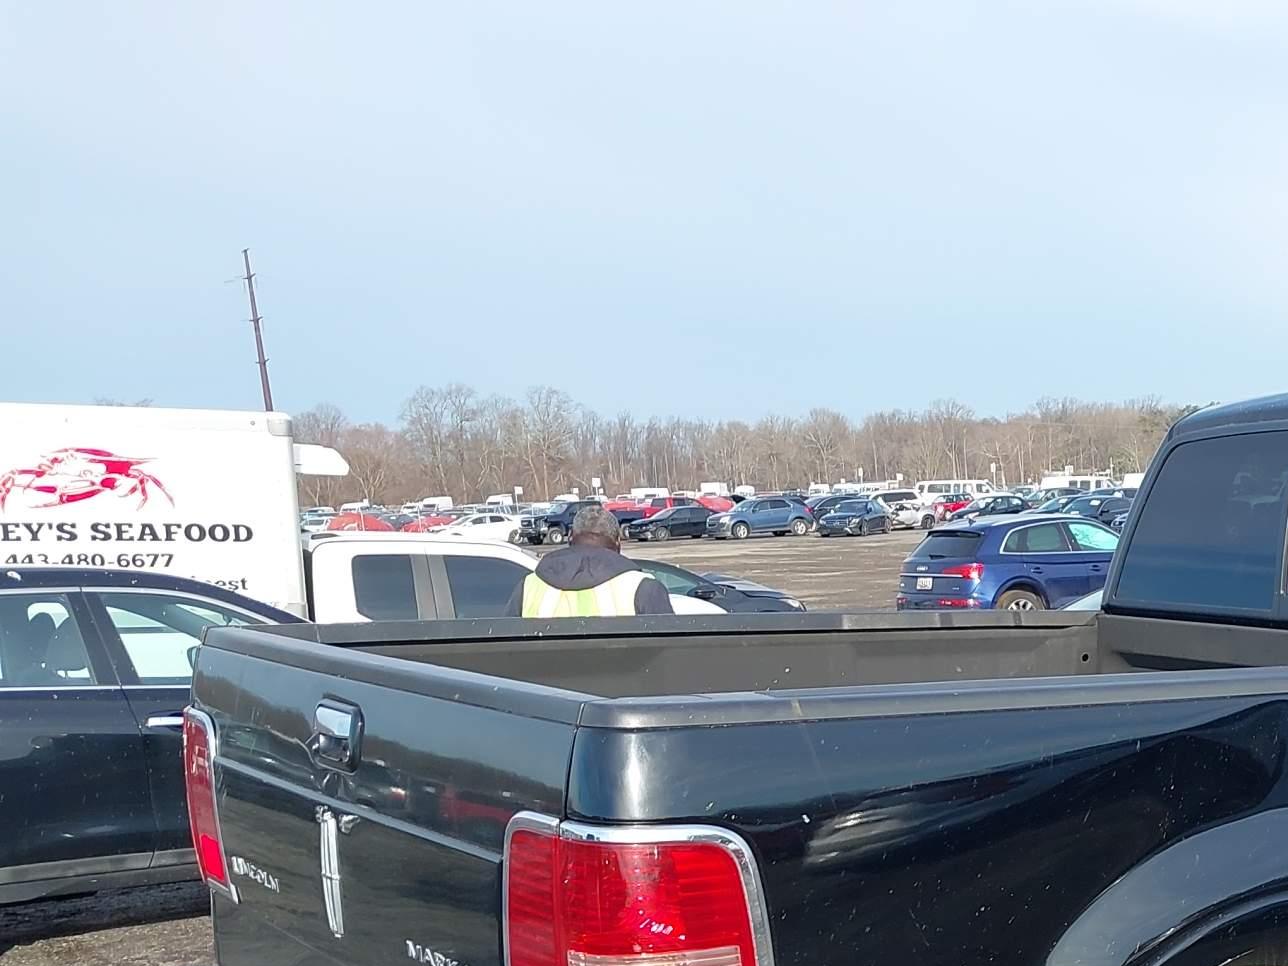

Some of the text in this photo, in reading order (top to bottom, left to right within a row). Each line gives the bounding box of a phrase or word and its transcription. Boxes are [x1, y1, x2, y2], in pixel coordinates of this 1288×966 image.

[0, 522, 254, 543] EY'S SEAFOOD
[5, 553, 174, 568] 443-480-6677
[231, 855, 280, 894] LINCOLN
